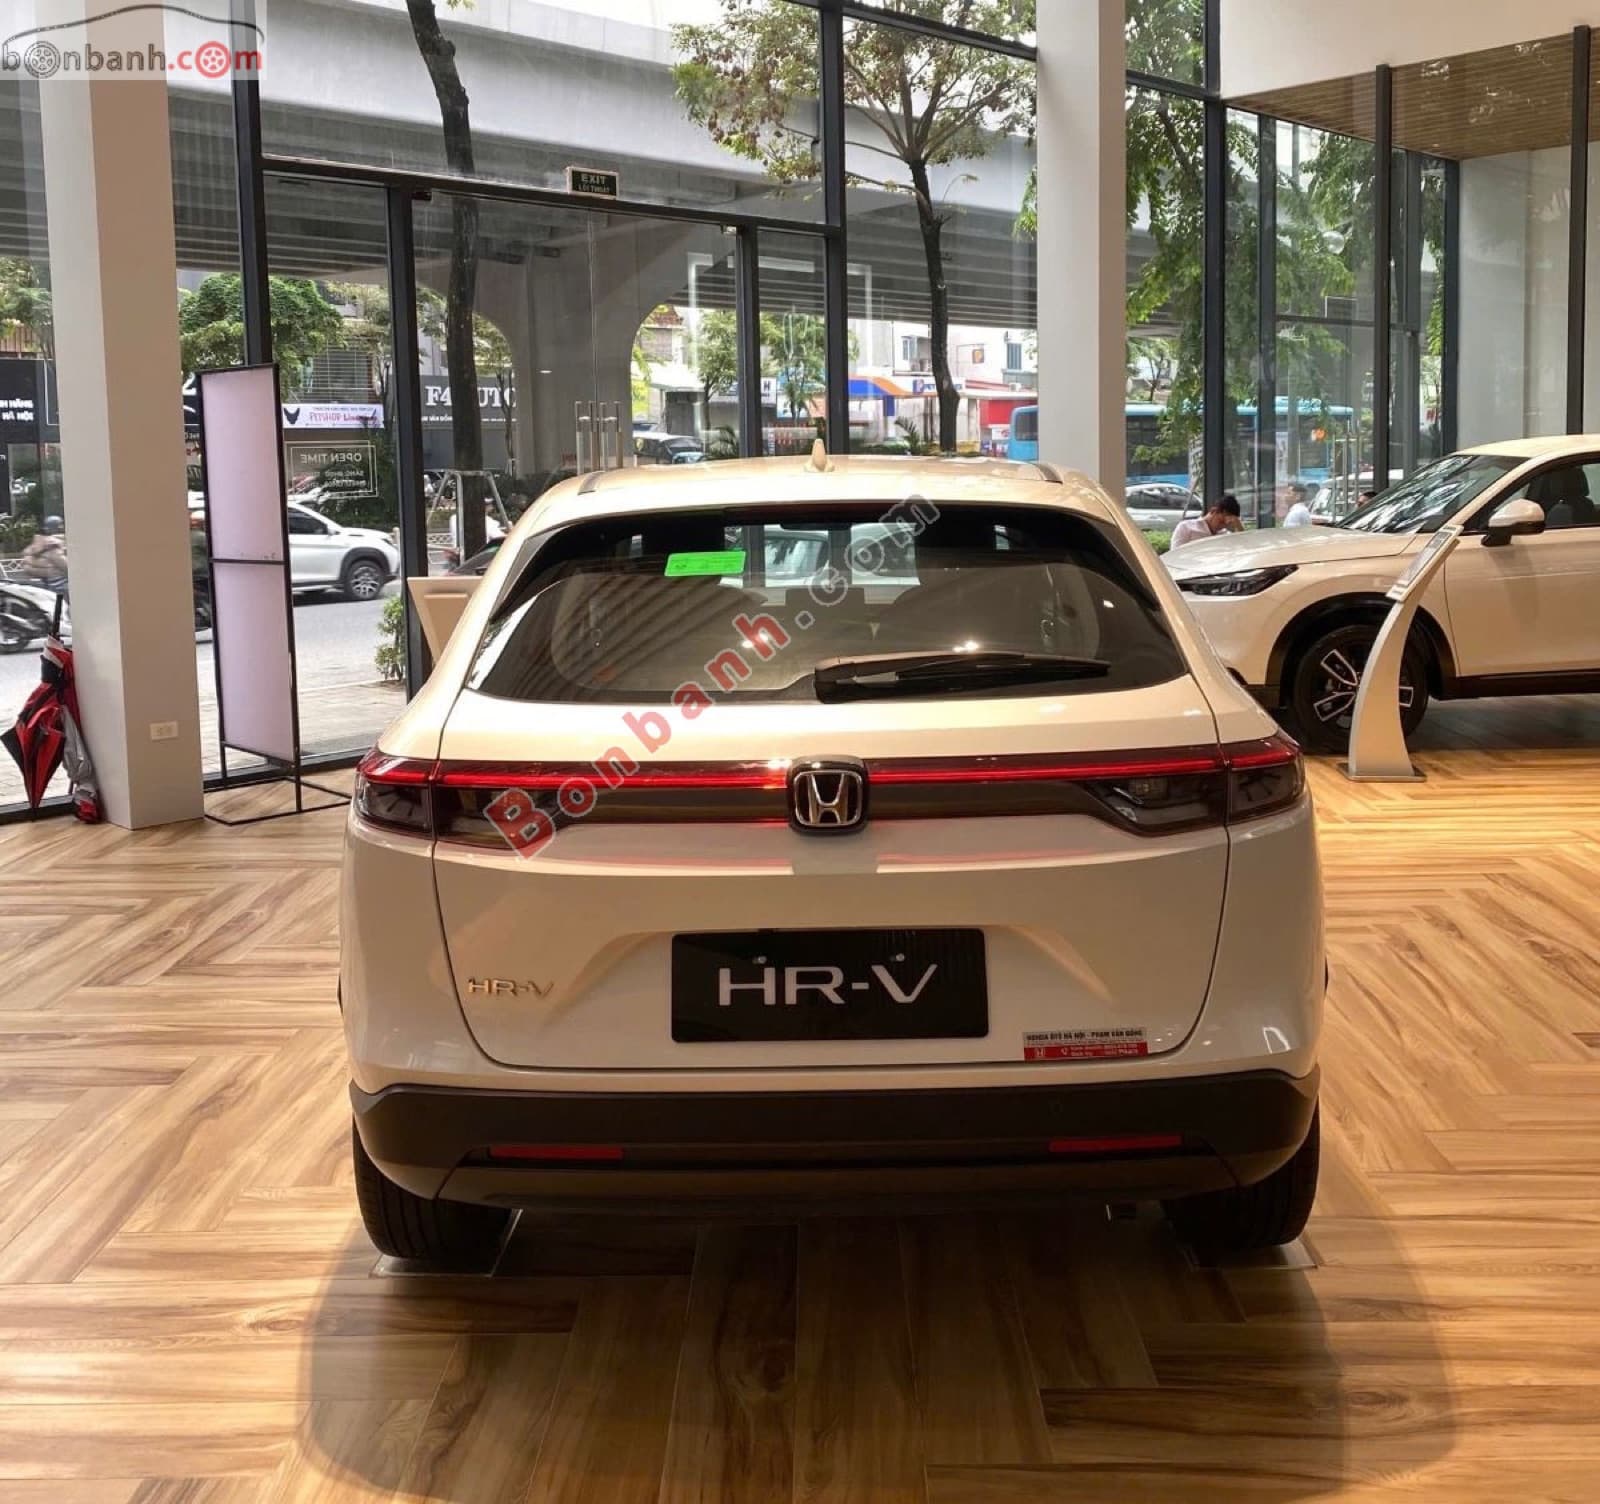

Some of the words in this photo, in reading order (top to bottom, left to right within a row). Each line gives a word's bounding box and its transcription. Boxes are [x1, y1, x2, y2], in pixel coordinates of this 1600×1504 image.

[581, 174, 607, 185] EXIT
[467, 978, 555, 998] HR-V
[718, 964, 938, 1006] HR-V
